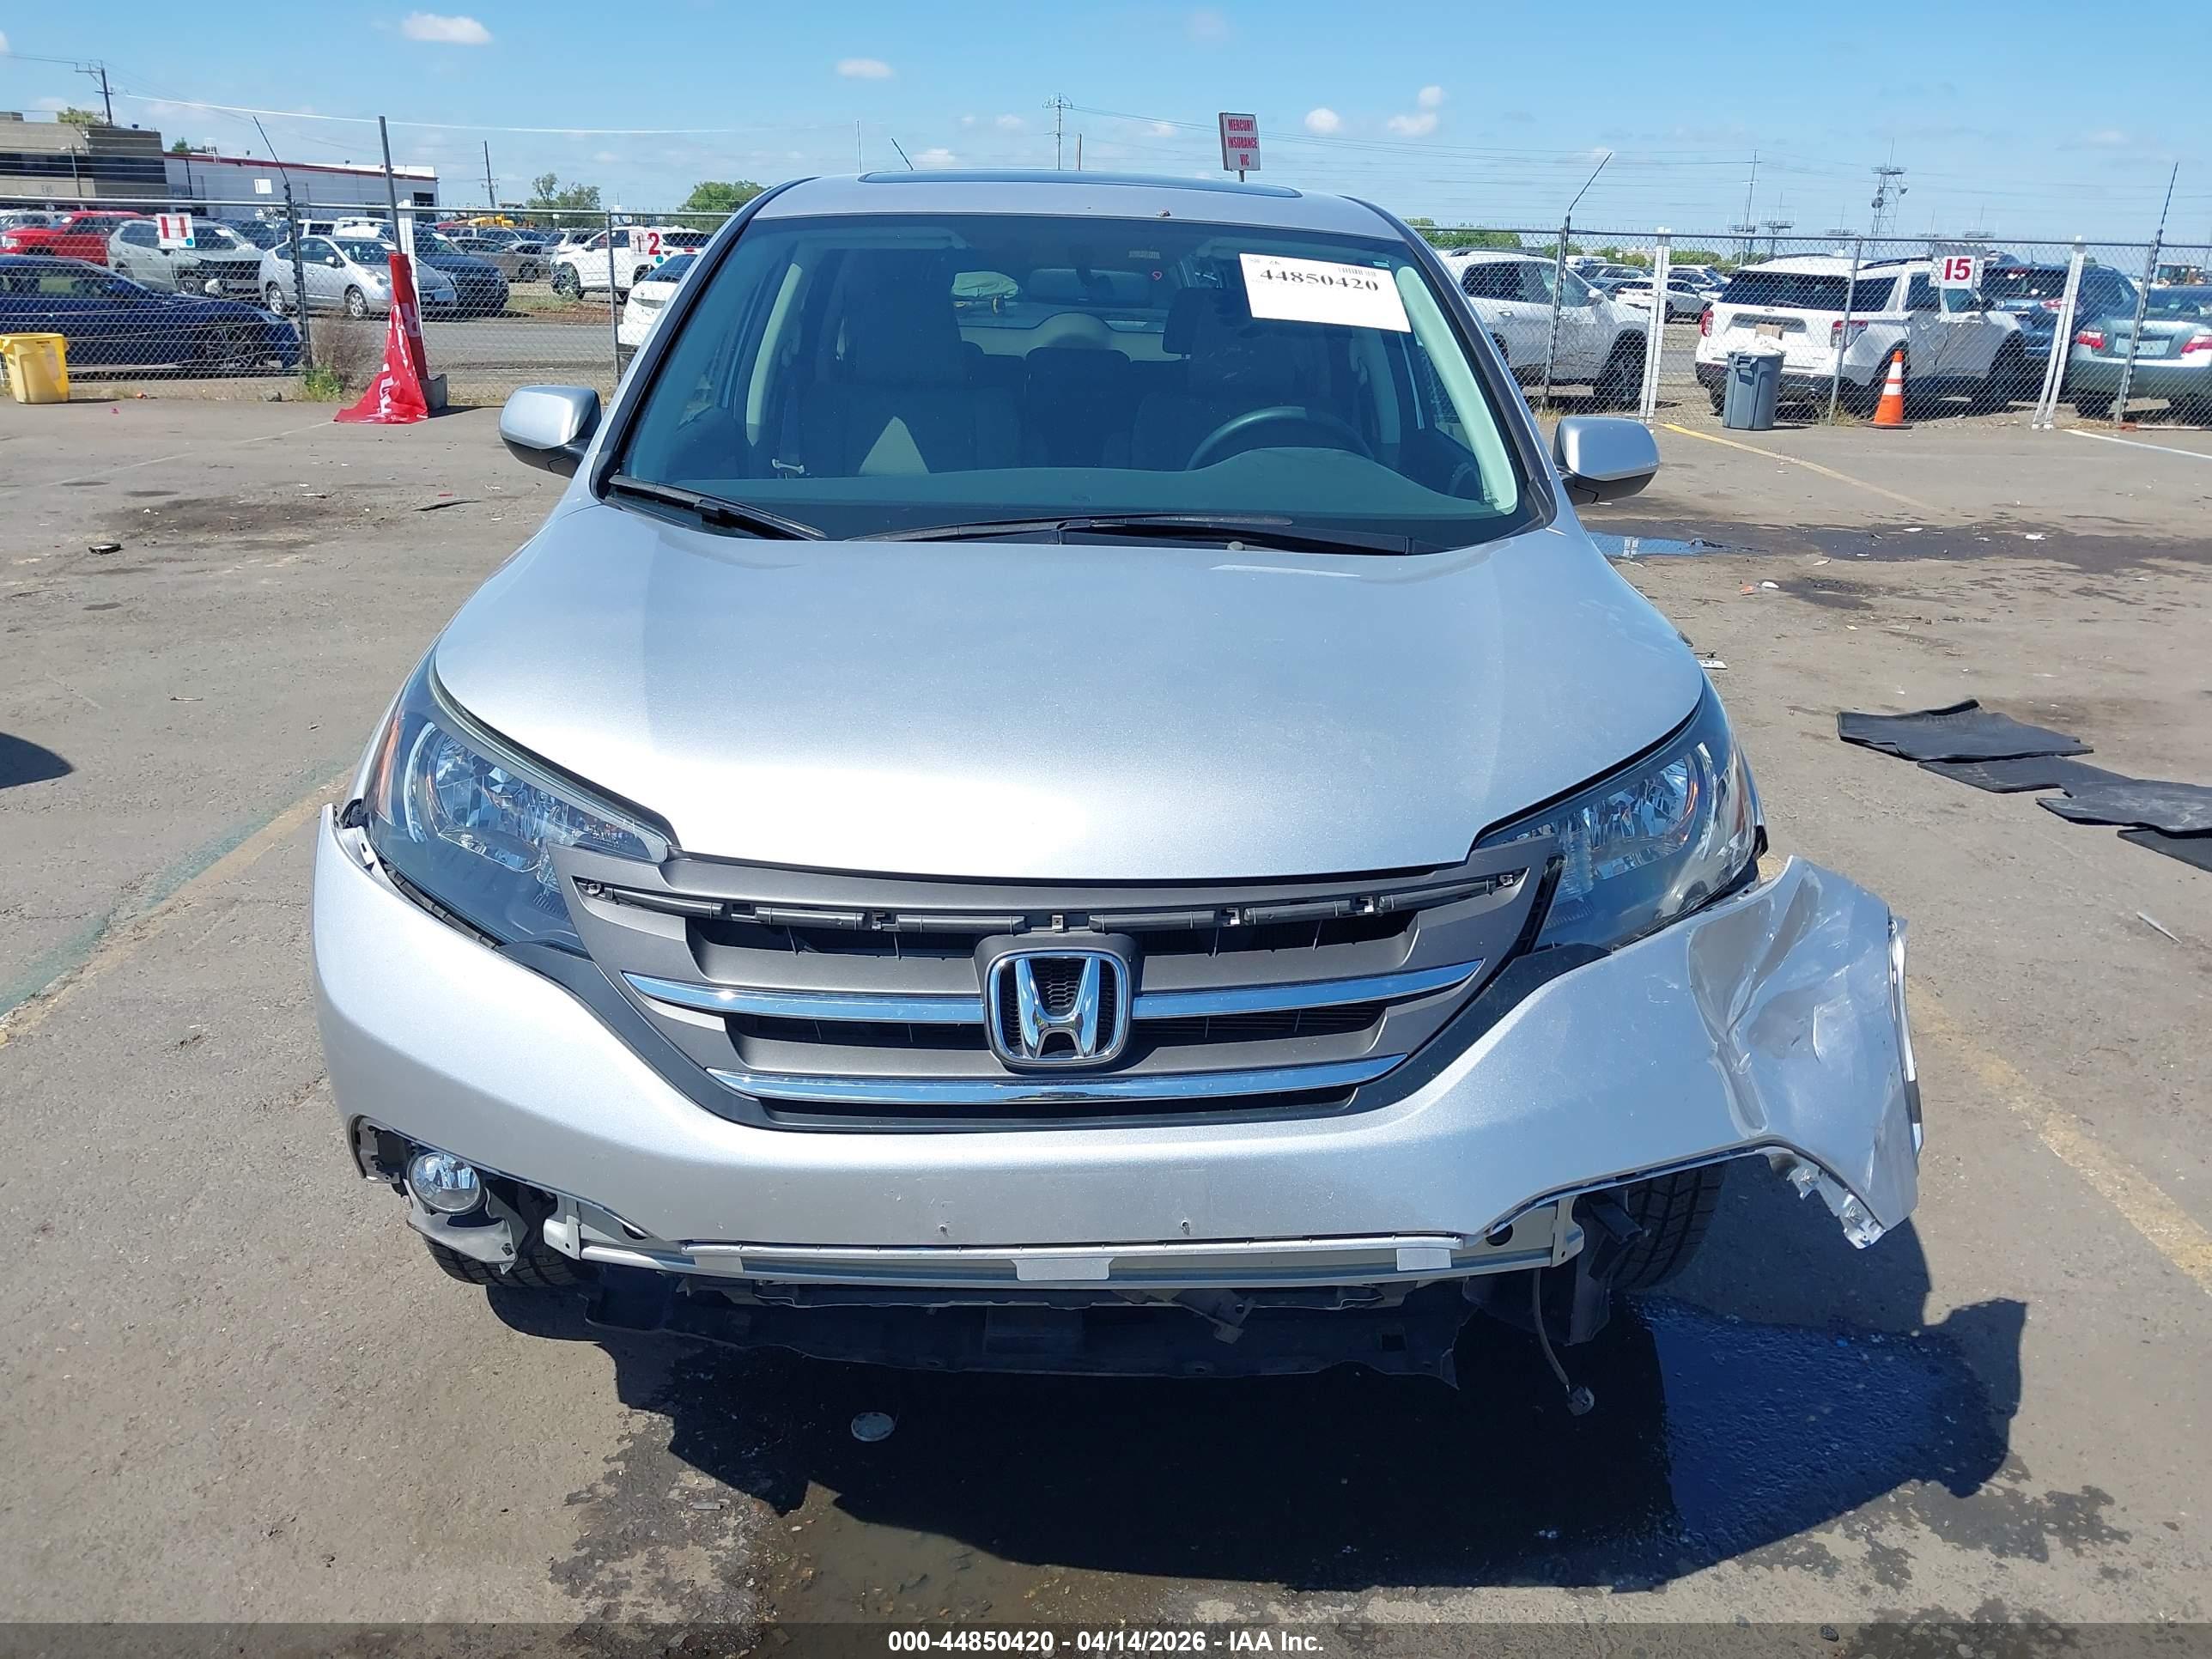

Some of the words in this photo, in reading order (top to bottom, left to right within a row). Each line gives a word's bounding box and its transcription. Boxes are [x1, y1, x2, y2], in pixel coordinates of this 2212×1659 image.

[1227, 118, 1254, 132] MERCURY
[1227, 137, 1258, 149] INSURANCE
[160, 216, 188, 240] 11
[636, 232, 661, 255] 12
[1260, 269, 1379, 291] 44850420
[1944, 258, 1972, 281] 15
